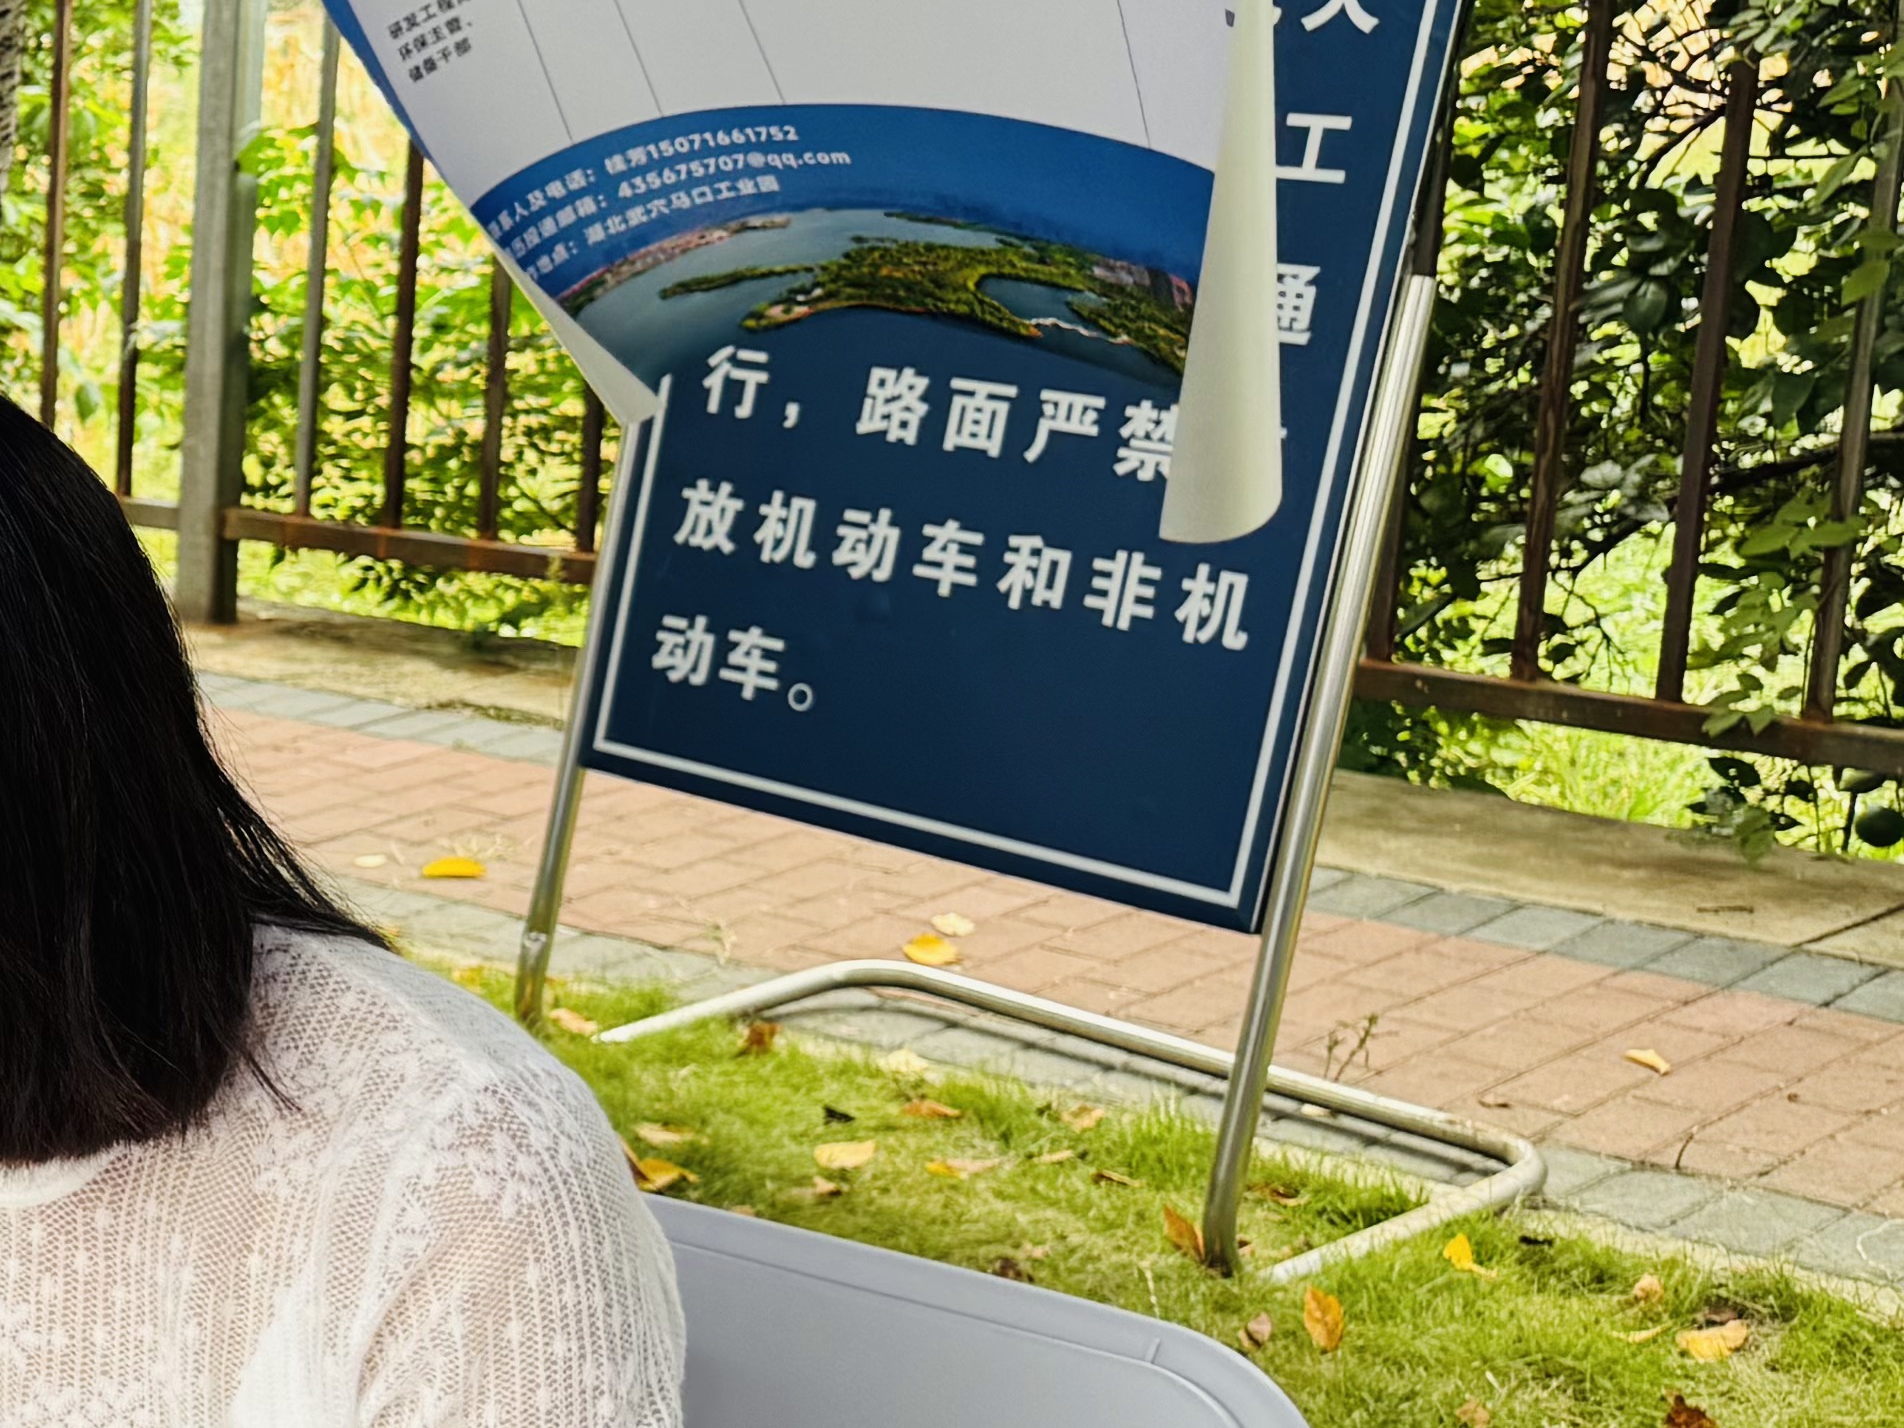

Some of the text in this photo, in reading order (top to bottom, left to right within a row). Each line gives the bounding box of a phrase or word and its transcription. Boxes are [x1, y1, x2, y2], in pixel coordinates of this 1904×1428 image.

[673, 478, 1252, 653] 放机动车和非机
[651, 611, 815, 717] 动车。
